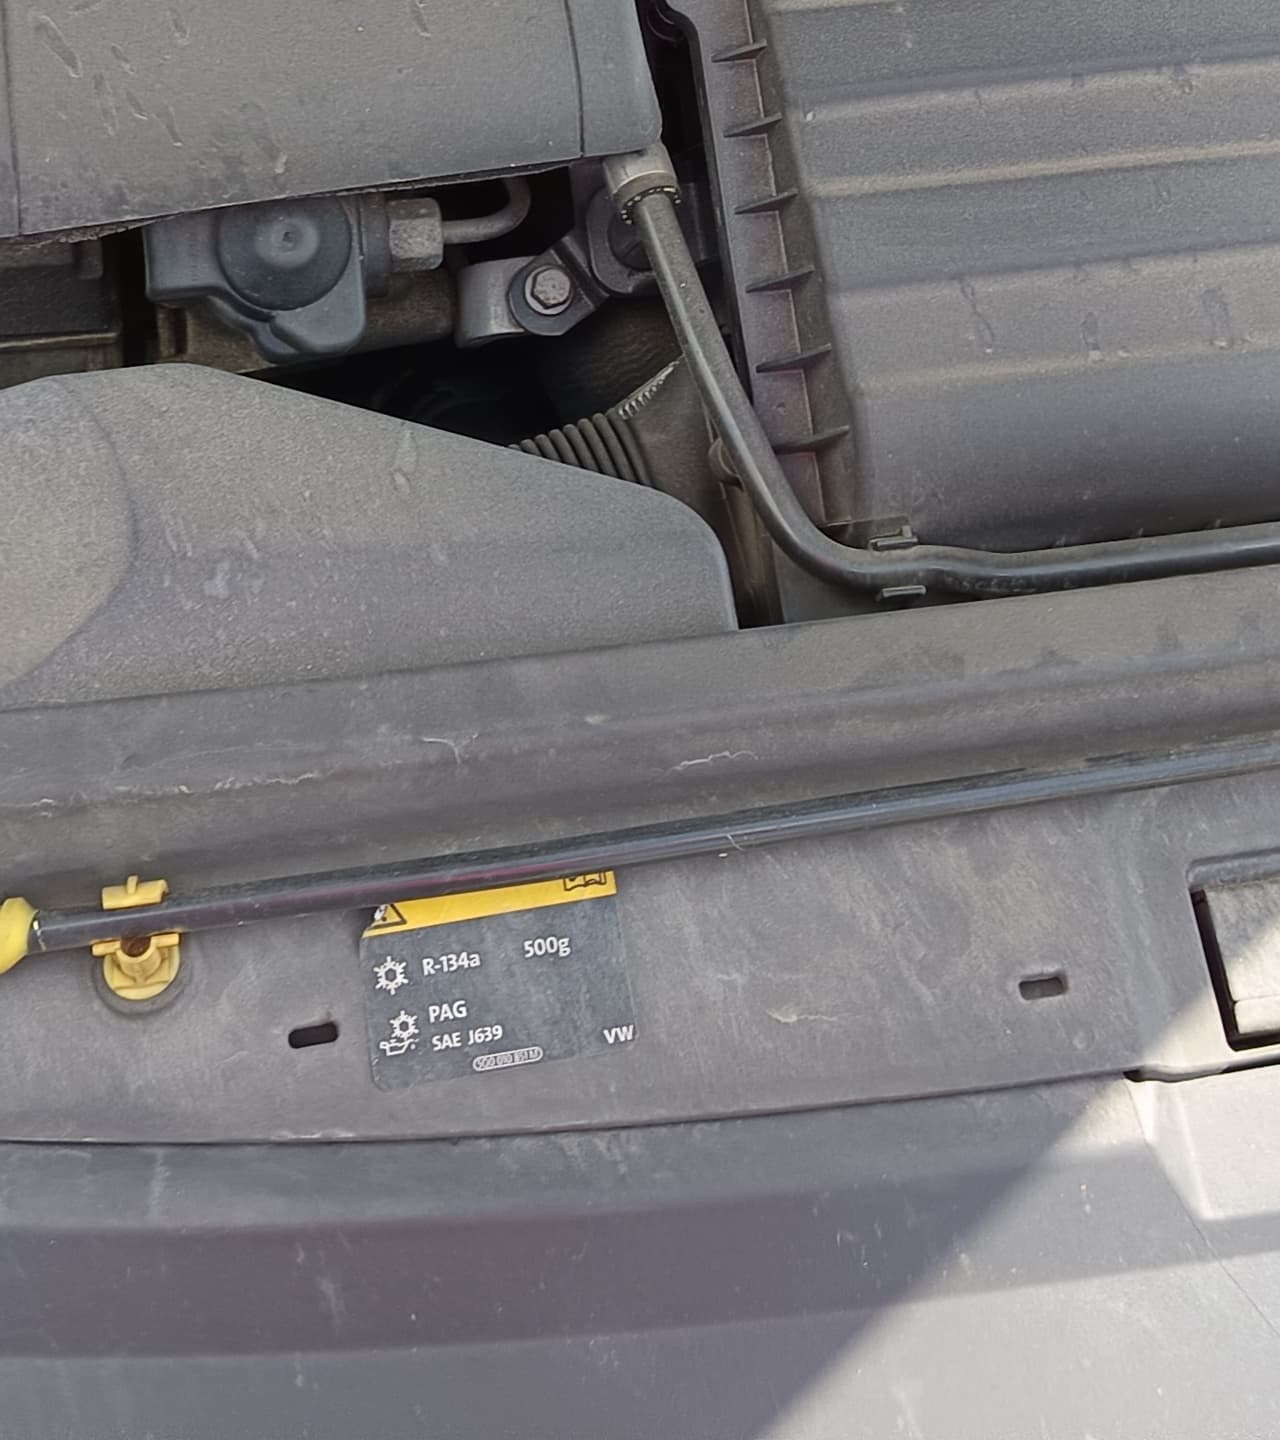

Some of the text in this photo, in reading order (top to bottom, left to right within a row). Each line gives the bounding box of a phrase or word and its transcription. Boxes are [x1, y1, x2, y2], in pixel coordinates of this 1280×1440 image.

[422, 936, 571, 976] R-134a 500g
[428, 1000, 467, 1023] PAG
[432, 1025, 503, 1051] SAE J639
[603, 1025, 634, 1044] VW
